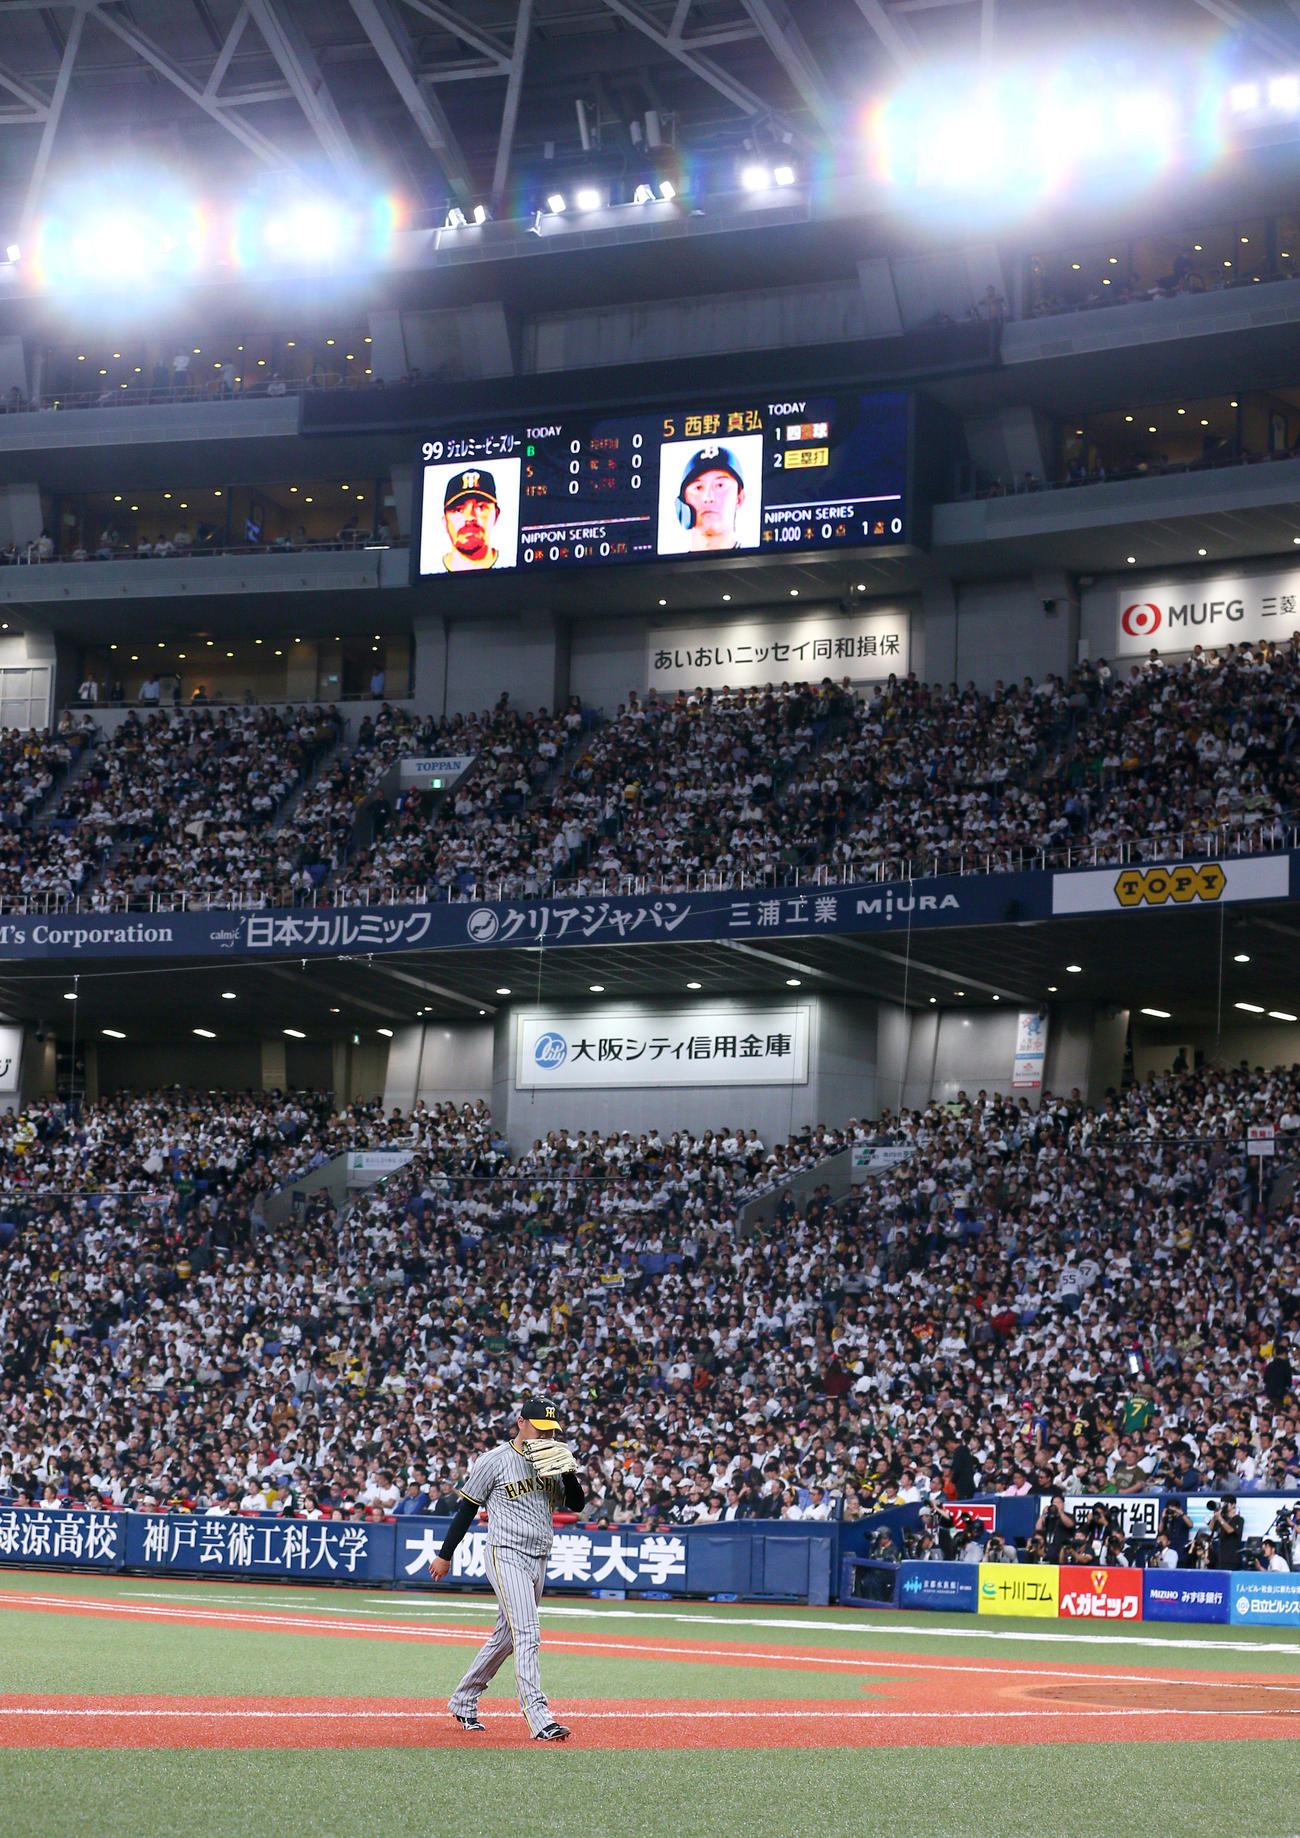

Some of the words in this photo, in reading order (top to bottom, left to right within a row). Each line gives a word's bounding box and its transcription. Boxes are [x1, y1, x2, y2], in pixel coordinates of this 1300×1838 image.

[768, 402, 806, 415] TODAY
[526, 426, 562, 439] TODAY
[663, 419, 675, 437] 5
[684, 414, 720, 437] 西野
[727, 410, 763, 433] 真弘
[632, 434, 643, 448] 0
[775, 427, 781, 441] 1
[422, 441, 443, 460] 99
[526, 445, 535, 457] B
[570, 440, 580, 454] 0
[569, 460, 580, 474] 0
[631, 454, 642, 468] 0
[773, 453, 782, 468] 2
[568, 480, 579, 494] 0
[631, 474, 641, 489] 0
[765, 510, 812, 524] NIPPON
[815, 506, 854, 520] SERIES
[521, 530, 566, 544] NIPPON
[569, 527, 606, 541] SERIES
[774, 526, 801, 542] 1.000
[821, 523, 832, 539] 0
[862, 521, 869, 535] 1
[891, 518, 902, 533] 0
[524, 549, 534, 563] 0
[549, 546, 559, 560] 0
[574, 544, 585, 559] 0
[600, 542, 610, 556] 0
[1168, 599, 1244, 627] MUFG
[1261, 595, 1297, 617] 三菱
[654, 634, 900, 670] あいおいニッセイ同和損保
[416, 762, 462, 772] TOPPAN
[1122, 875, 1218, 896] TOPY
[501, 902, 691, 941] クリアジャパン
[729, 897, 838, 927] 三浦工業
[32, 923, 173, 948] Corporation
[247, 912, 432, 947] 日本カルミック
[570, 1033, 792, 1062] 大阪シティ信用金庫
[1062, 1275, 1077, 1285] 55
[1130, 1403, 1142, 1417] 7
[143, 1518, 369, 1573] 神戸芸術工科大学
[405, 1529, 686, 1584] 大阪業大学
[999, 1581, 1054, 1601] 十川ゴム
[1150, 1589, 1178, 1600] MIZUHO
[1181, 1591, 1223, 1605] みずほ銀行
[1060, 1592, 1139, 1618] ベガビック
